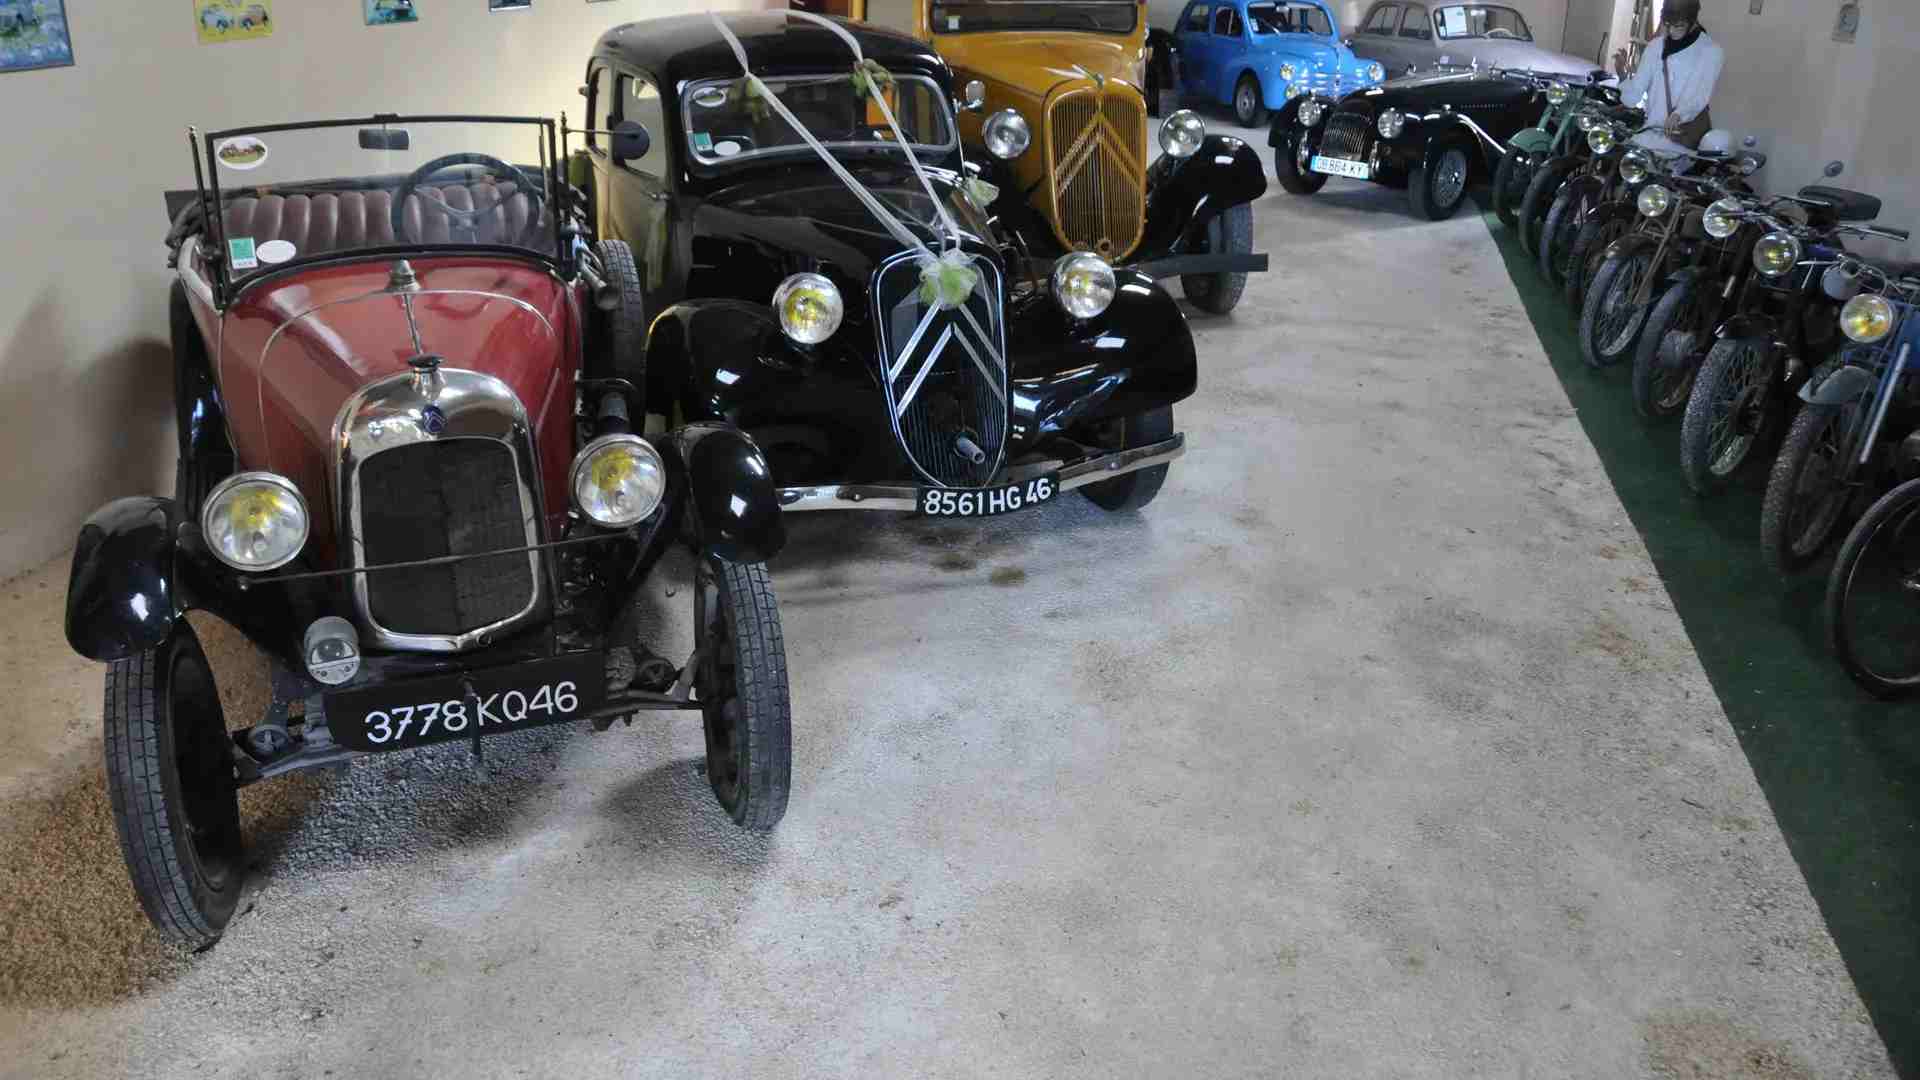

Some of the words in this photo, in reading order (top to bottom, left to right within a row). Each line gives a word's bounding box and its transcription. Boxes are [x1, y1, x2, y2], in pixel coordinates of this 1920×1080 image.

[925, 490, 983, 515] 8561
[989, 486, 1022, 514] HG
[1025, 478, 1053, 504] 46
[364, 701, 468, 743] 3778
[477, 681, 578, 726] KQ46
